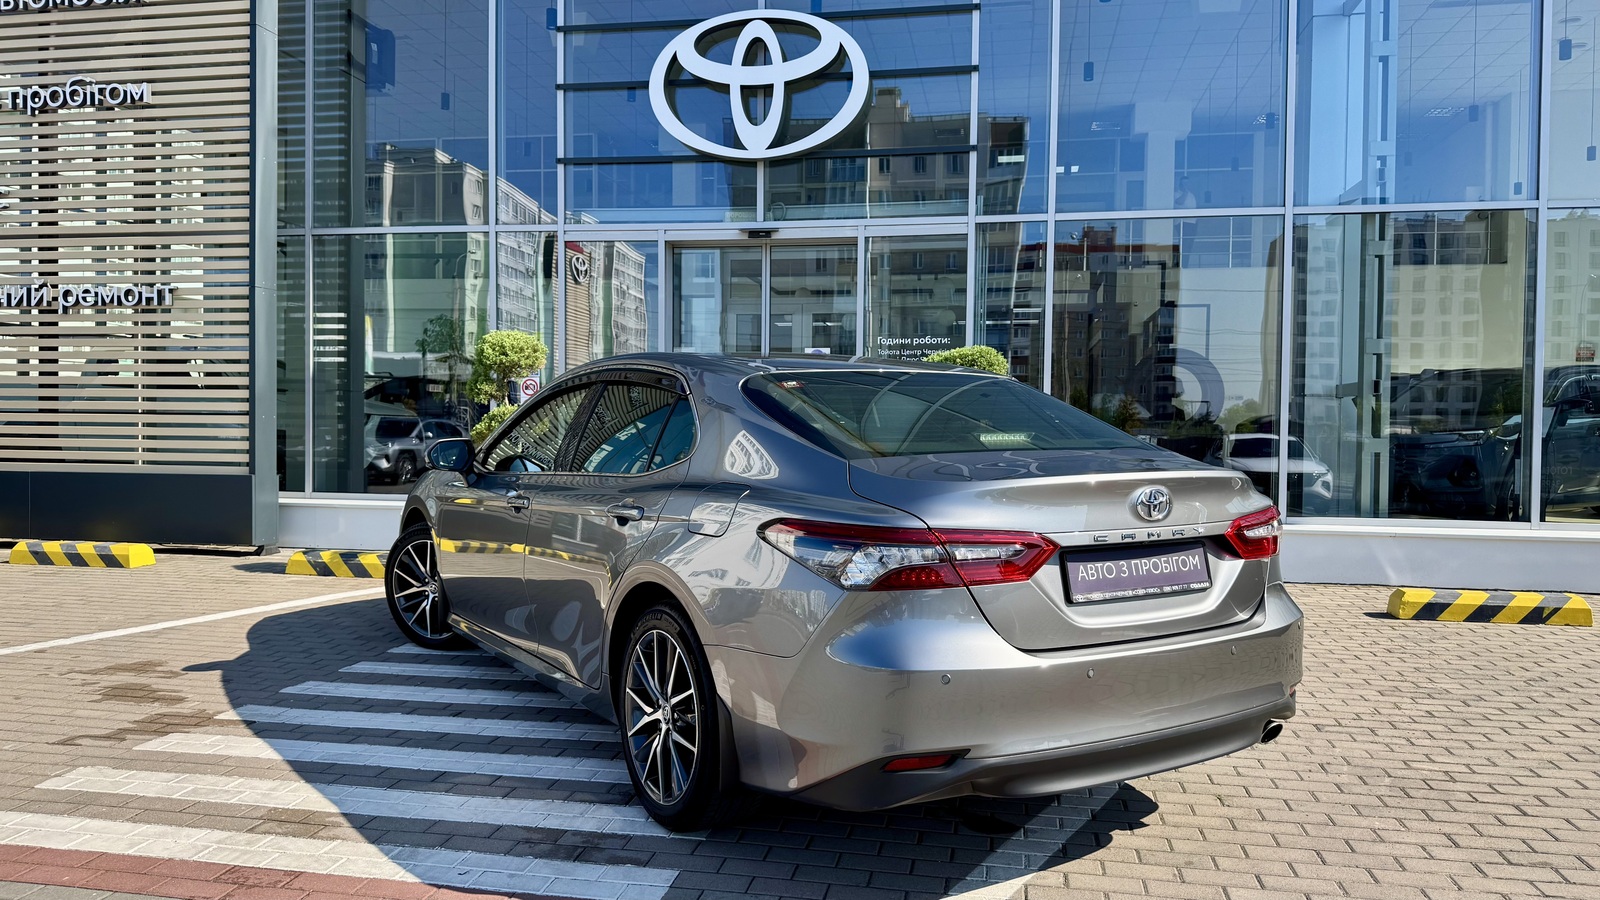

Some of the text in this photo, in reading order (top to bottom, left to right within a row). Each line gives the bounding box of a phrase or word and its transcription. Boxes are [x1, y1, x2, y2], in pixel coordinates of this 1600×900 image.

[8, 76, 151, 116] пробігом
[59, 285, 174, 314] ремонт
[877, 335, 951, 346] Години роботи:
[1093, 527, 1206, 543] CAMRY
[1078, 561, 1116, 581] АВТО
[1132, 554, 1201, 576] ПРОБІГОМ
